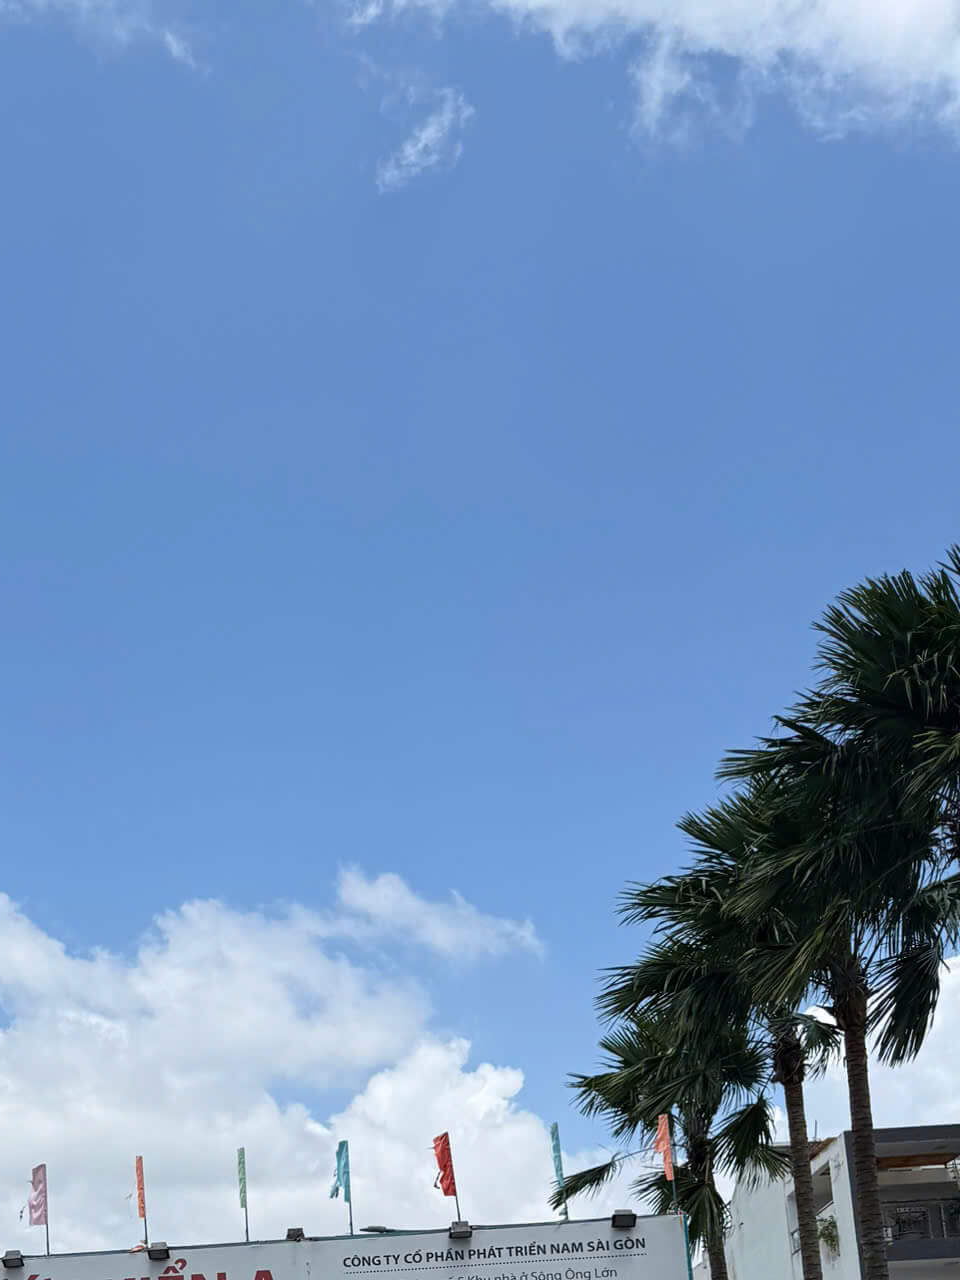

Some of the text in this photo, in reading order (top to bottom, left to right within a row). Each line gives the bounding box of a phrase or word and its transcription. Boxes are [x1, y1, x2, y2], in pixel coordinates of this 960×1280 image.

[343, 1255, 381, 1267] CÔNG
[383, 1255, 400, 1265] TY
[468, 1246, 503, 1259] PHÁT
[506, 1241, 546, 1257] TRIỂN
[550, 1242, 583, 1254] NAM
[587, 1239, 609, 1252] SÀI
[613, 1237, 645, 1250] GÒN
[595, 1267, 618, 1279] Lớn
